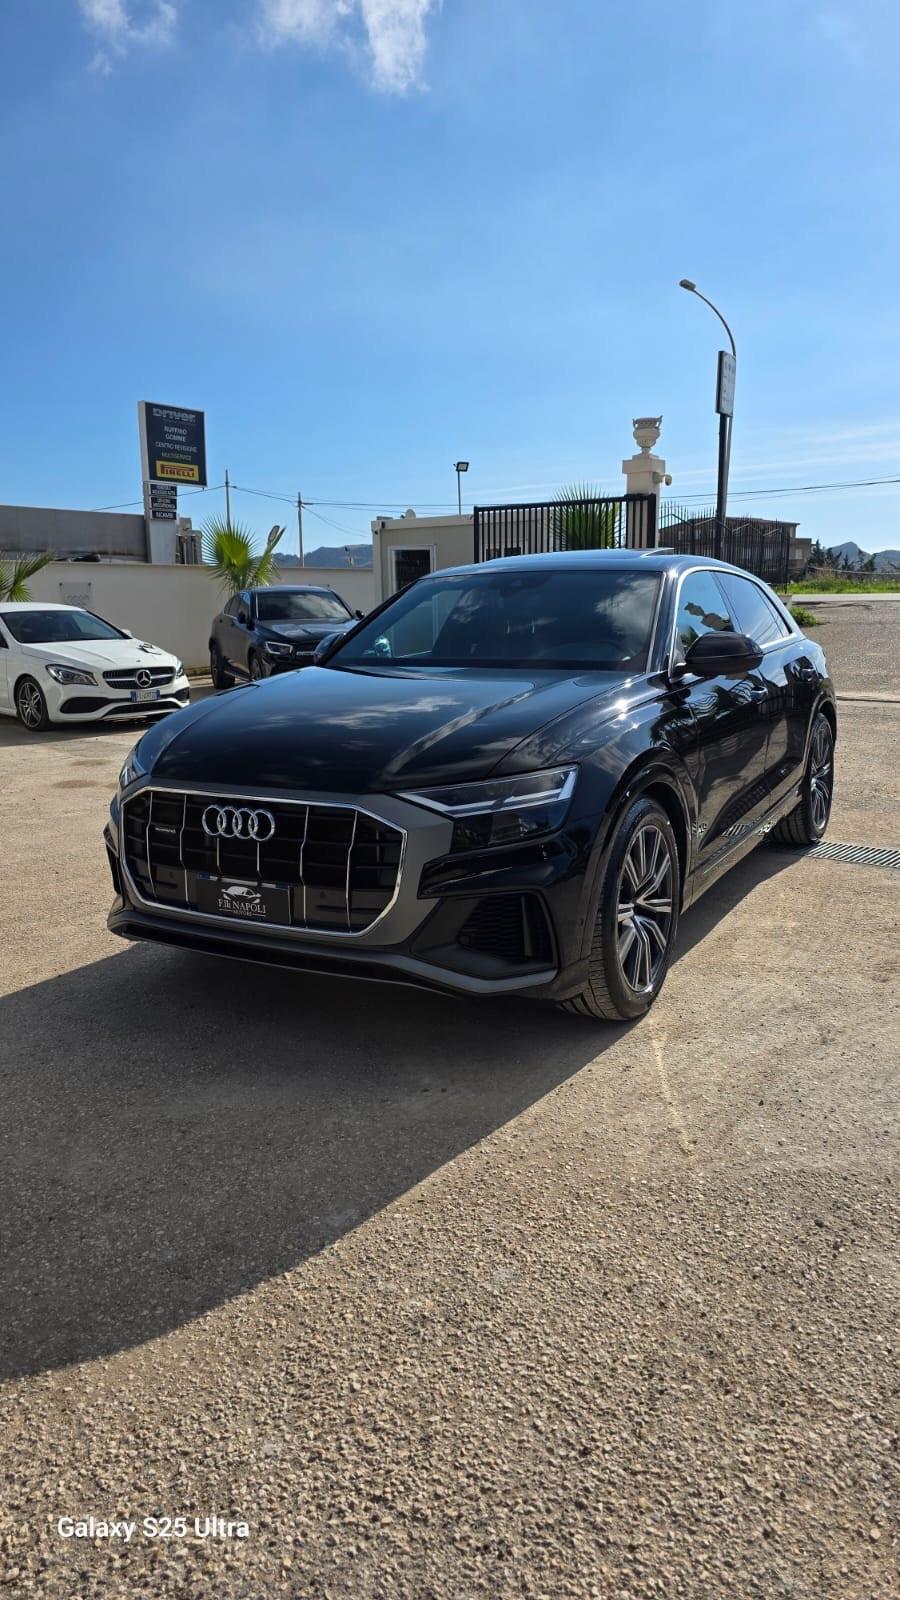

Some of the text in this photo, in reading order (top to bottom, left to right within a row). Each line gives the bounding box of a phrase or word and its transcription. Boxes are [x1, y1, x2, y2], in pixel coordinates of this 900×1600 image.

[155, 441, 175, 450] CENTRO
[160, 463, 195, 478] PIRELLI
[232, 901, 266, 913] NAPOLI
